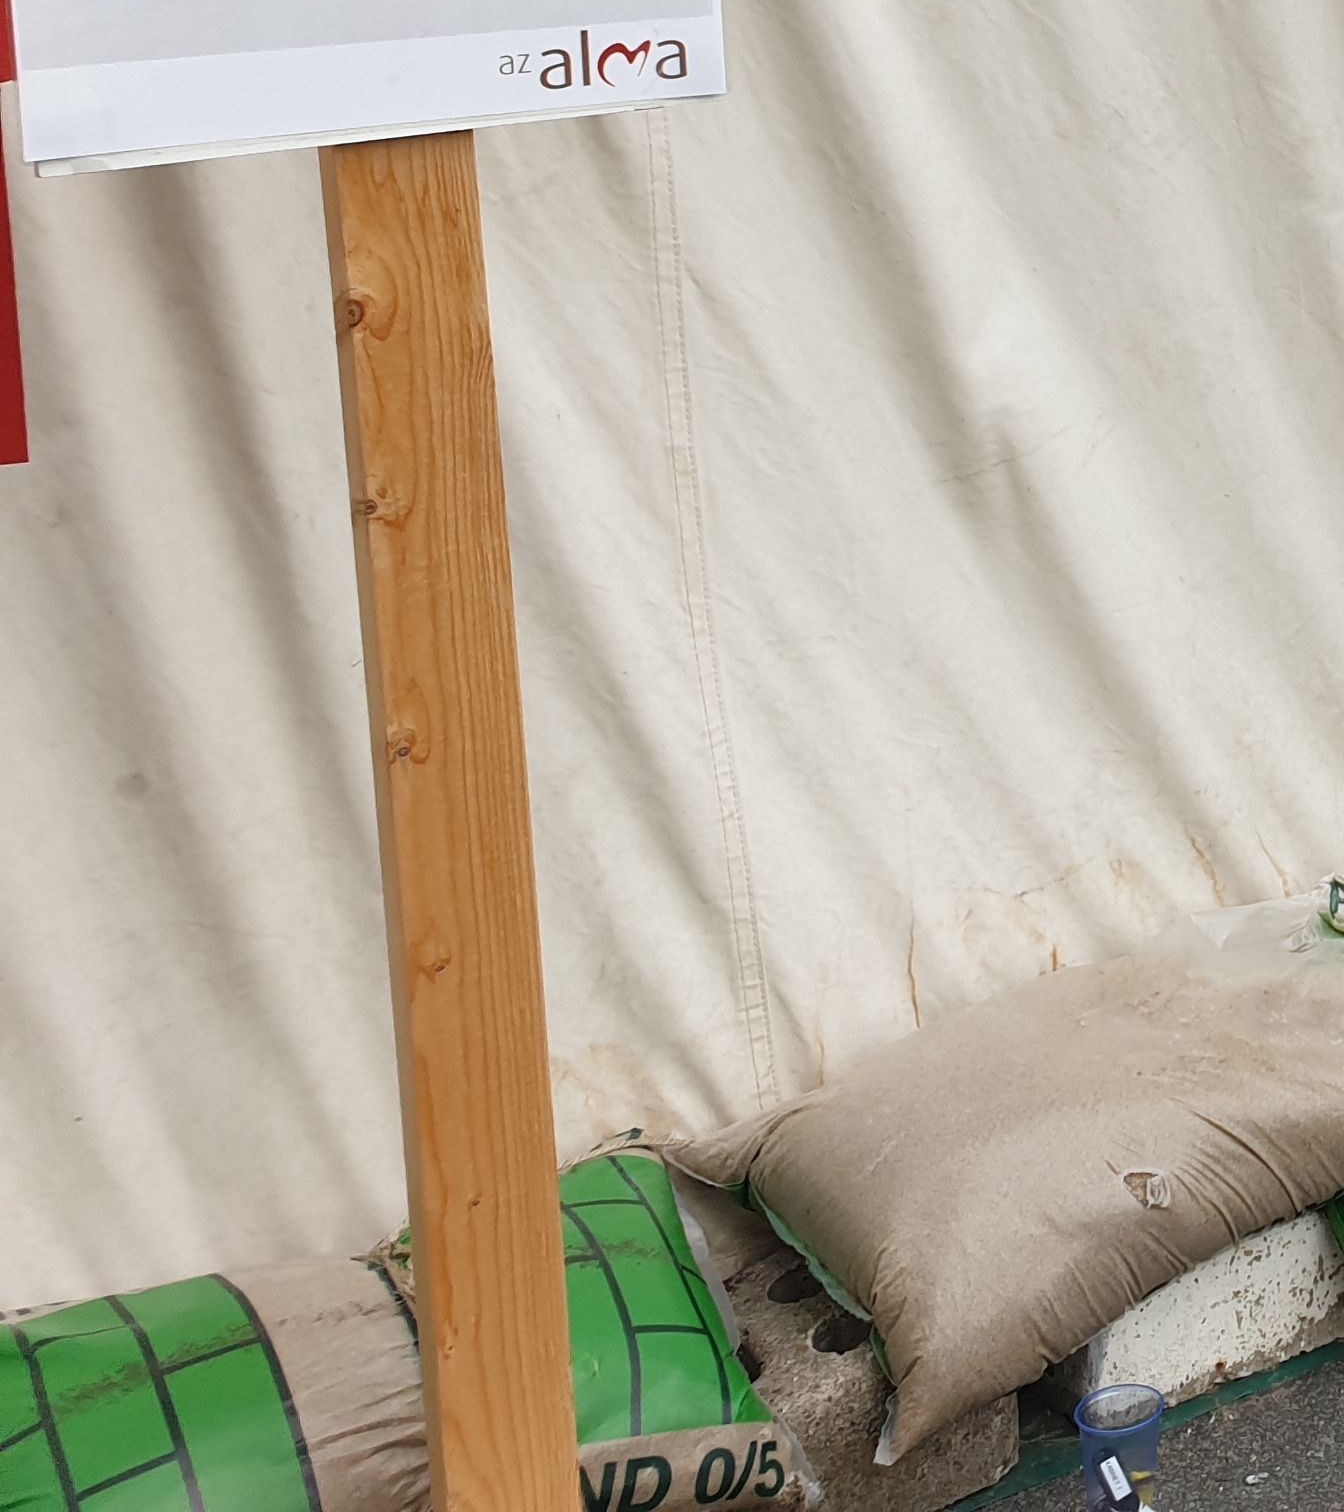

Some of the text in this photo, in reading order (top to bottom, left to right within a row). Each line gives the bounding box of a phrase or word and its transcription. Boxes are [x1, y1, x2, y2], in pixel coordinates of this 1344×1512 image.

[498, 29, 688, 89] az alma
[694, 1439, 786, 1505] 0/5
